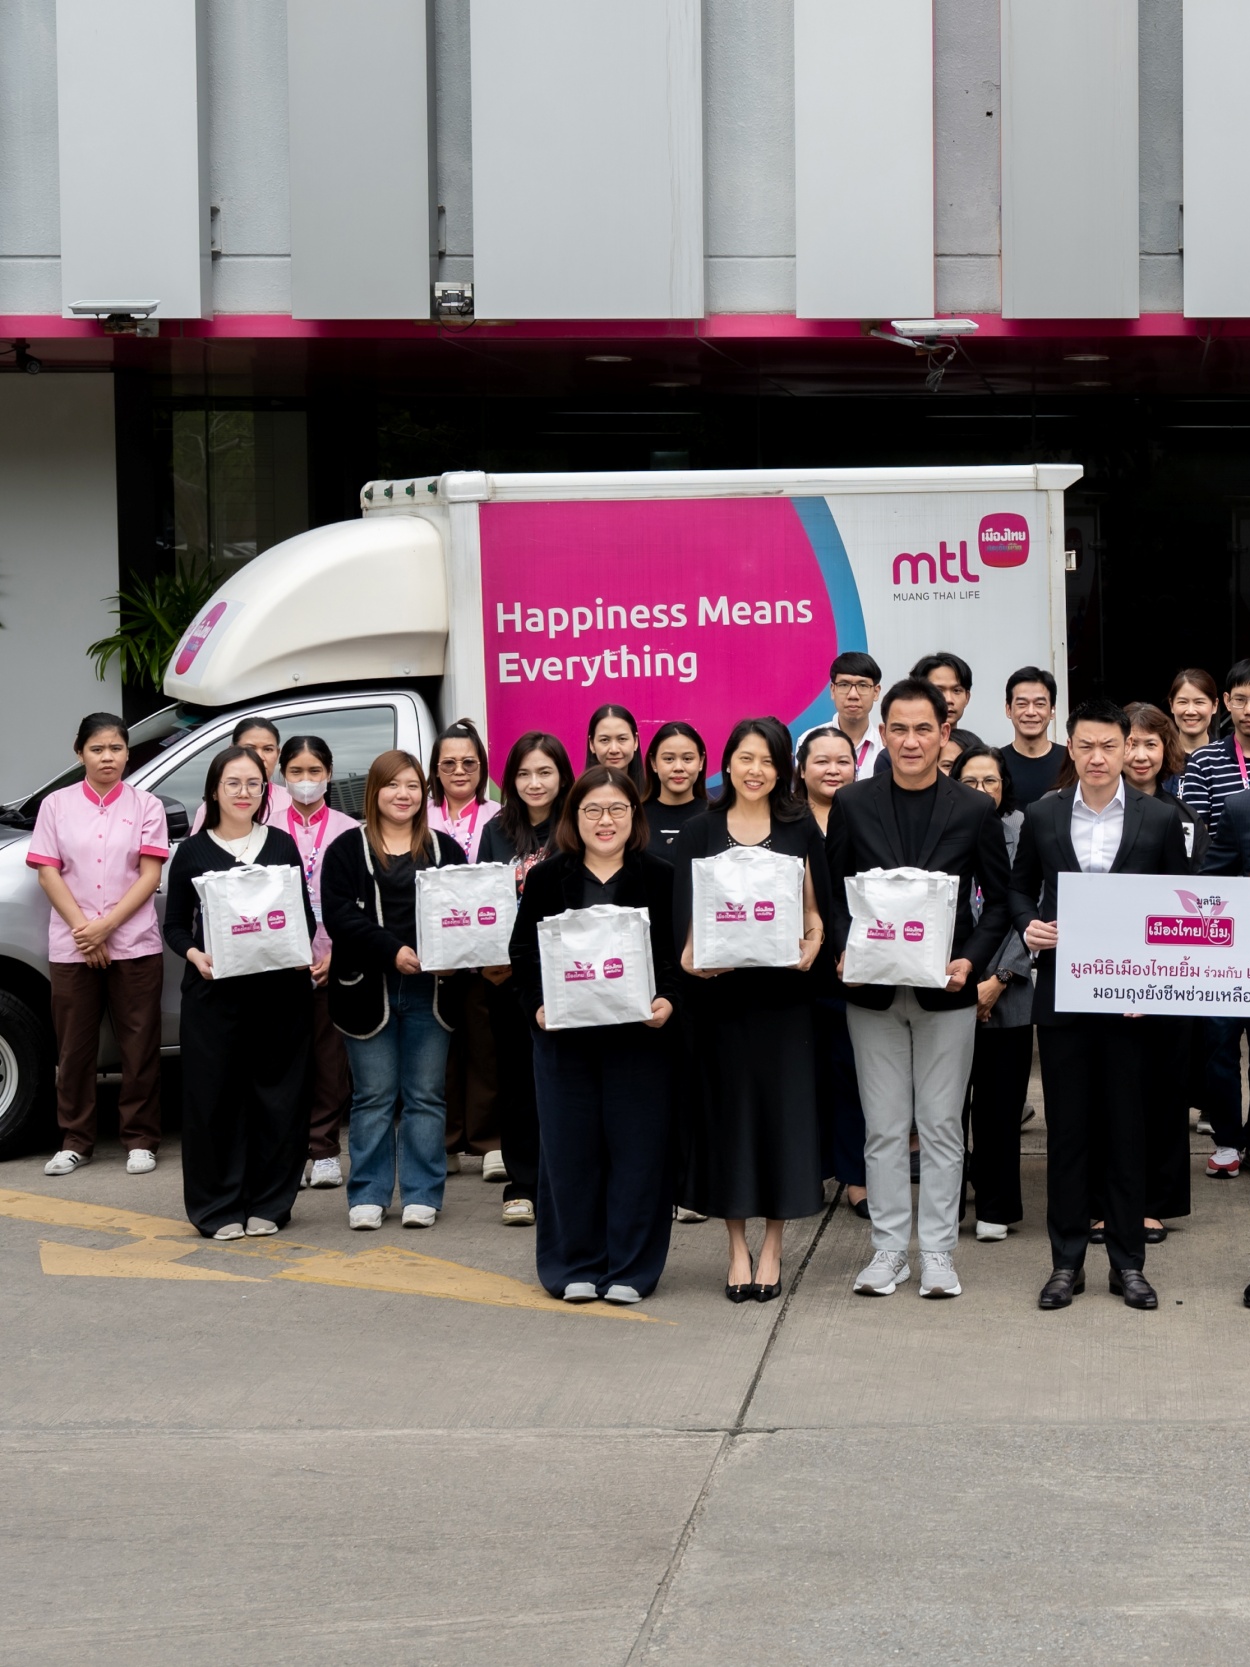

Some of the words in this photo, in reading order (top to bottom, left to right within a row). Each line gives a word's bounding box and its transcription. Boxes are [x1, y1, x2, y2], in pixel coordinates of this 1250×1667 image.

[981, 527, 1026, 541] เมืองไทย
[893, 541, 981, 584] mtl
[893, 593, 930, 602] MUANG
[933, 592, 956, 600] THAI
[960, 591, 981, 600] LIFE
[496, 597, 688, 639] Happiness
[698, 595, 813, 627] Means
[498, 645, 698, 687] Everything
[1196, 896, 1221, 908] มูลนิธิ
[1148, 919, 1202, 937] เมืองไทย
[1209, 919, 1229, 938] ยิ้ม
[1070, 956, 1200, 979] มูลนิธิเมืองไทยยิ้ม
[1203, 966, 1242, 979] ร่วมกับ
